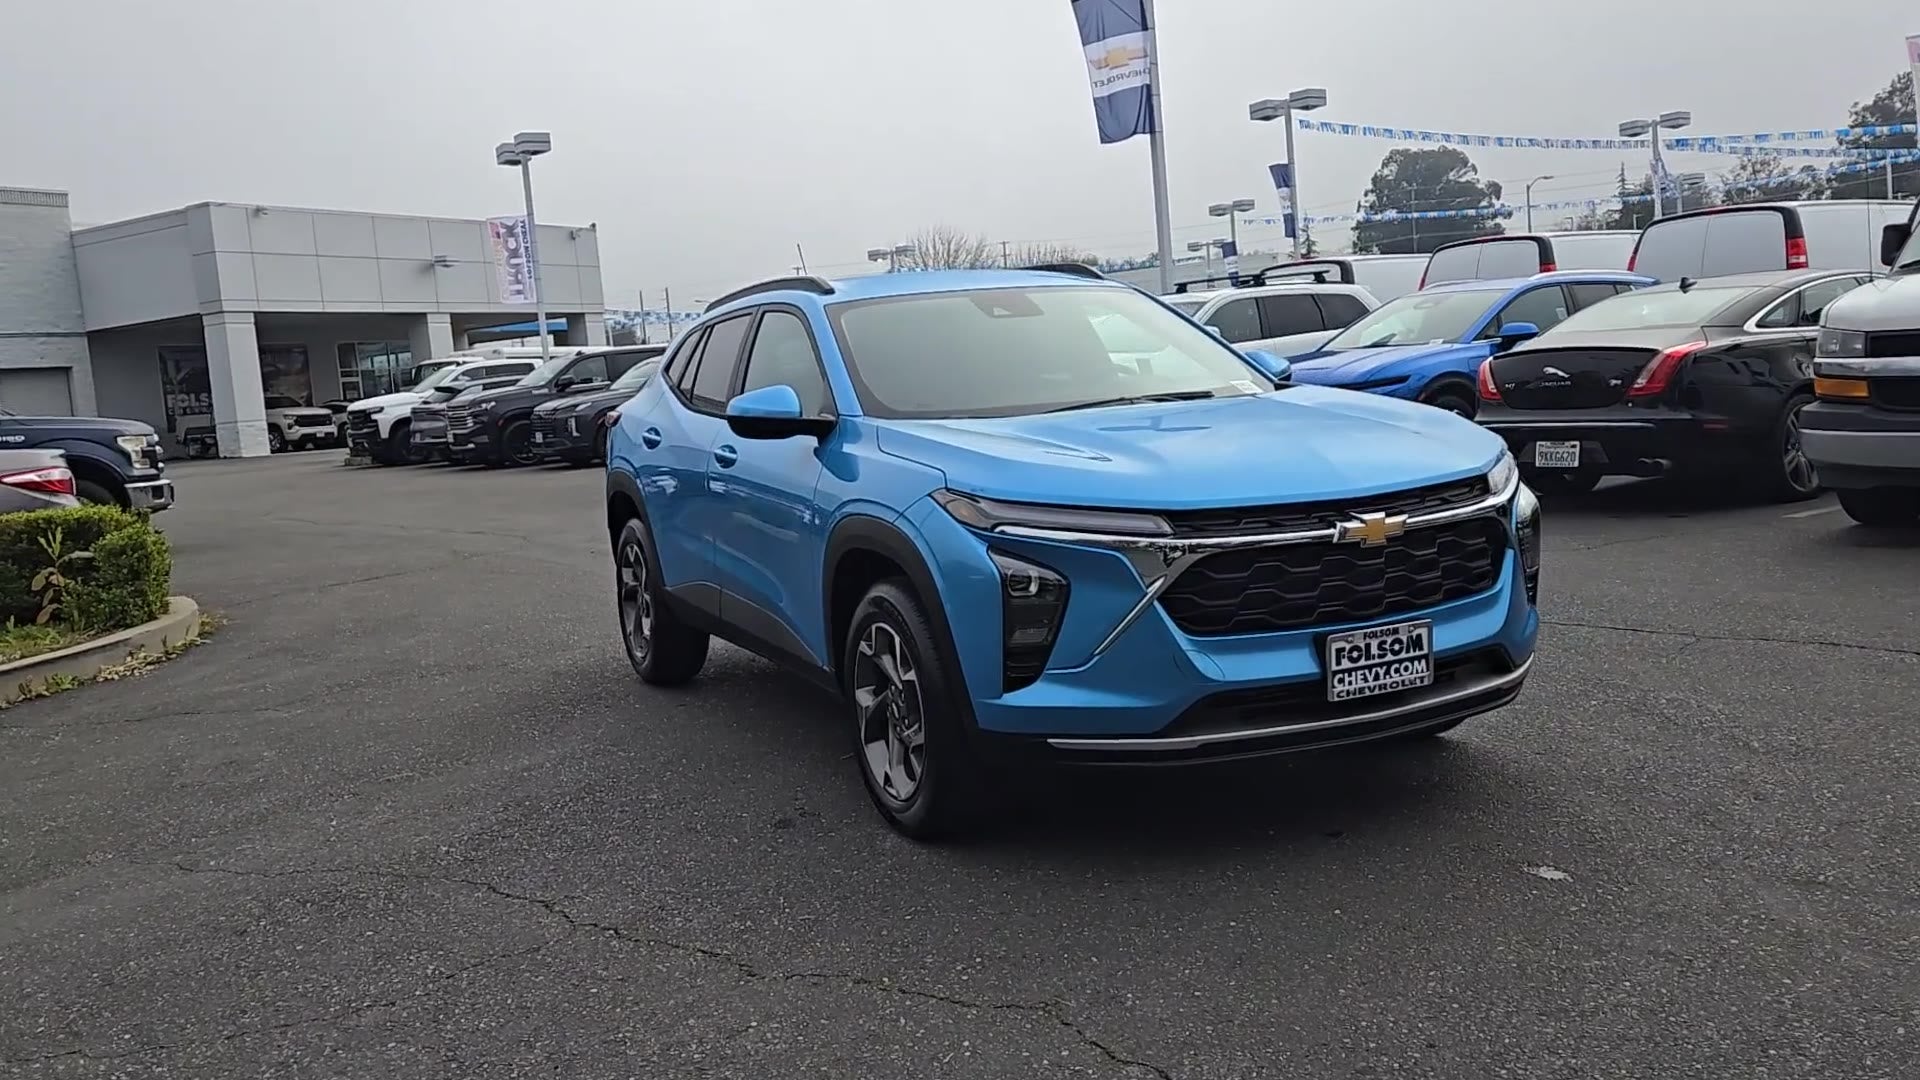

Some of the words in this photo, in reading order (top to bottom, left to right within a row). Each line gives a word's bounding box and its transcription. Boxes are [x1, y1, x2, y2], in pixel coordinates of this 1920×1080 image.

[165, 393, 209, 408] FOLS
[1363, 626, 1400, 641] FOLSOM
[1335, 632, 1424, 667] FOLSOM
[1333, 658, 1428, 689] CHEVY.COM
[1336, 676, 1427, 699] CHEVROLET
